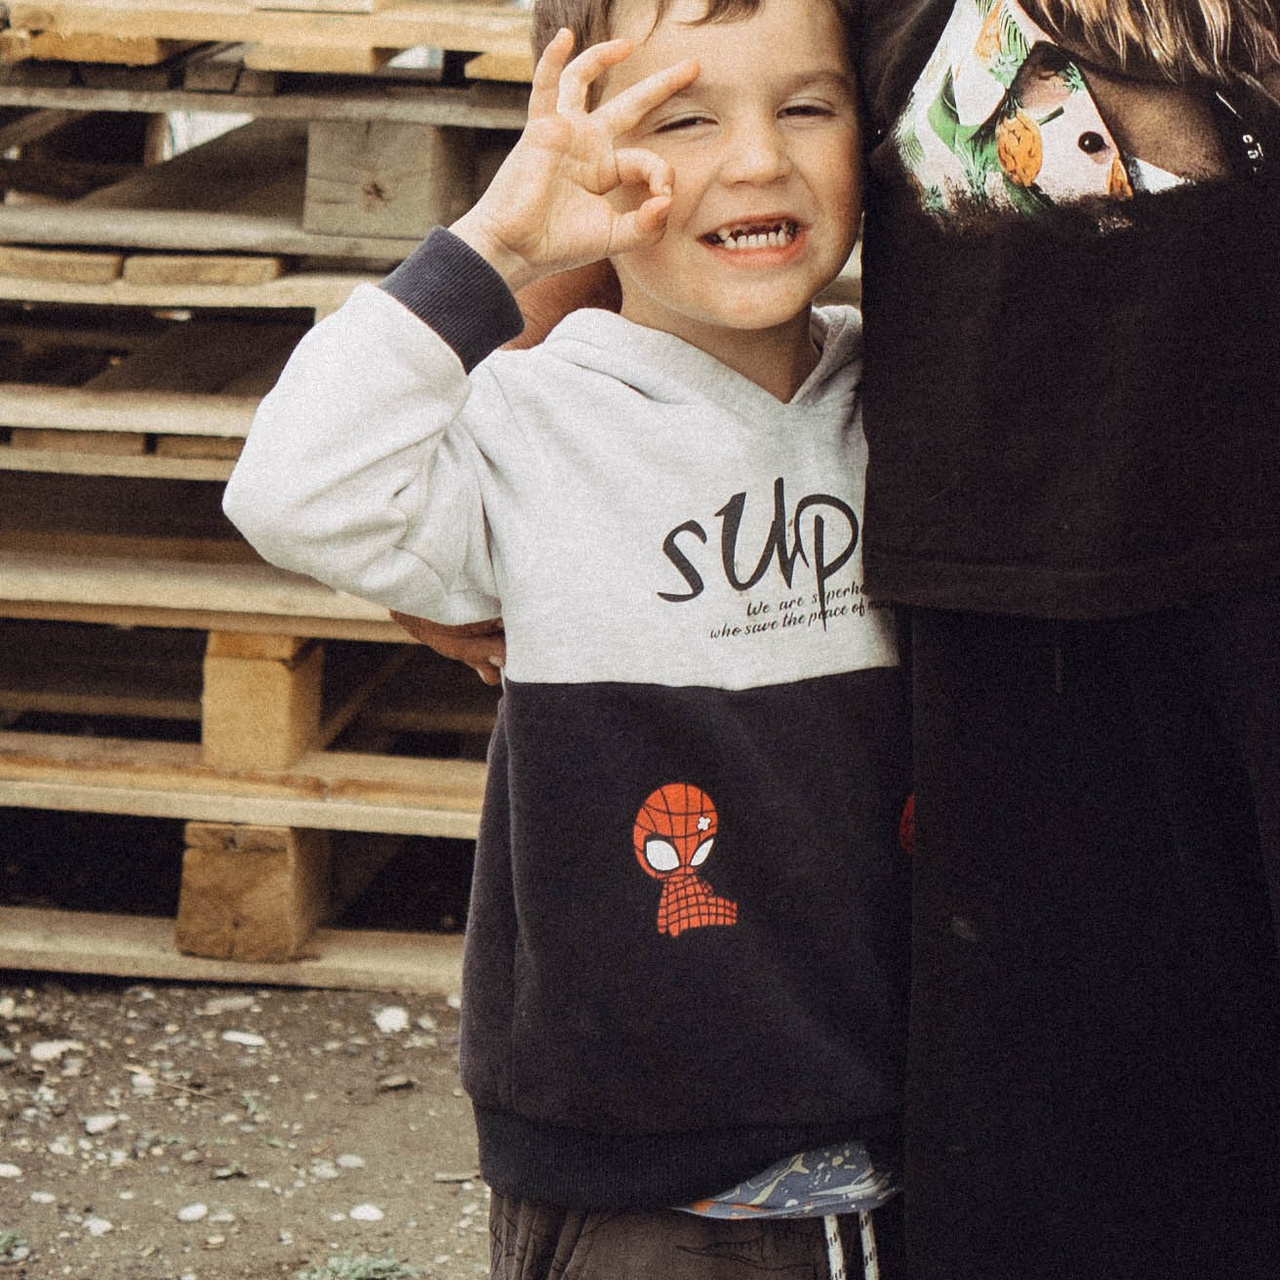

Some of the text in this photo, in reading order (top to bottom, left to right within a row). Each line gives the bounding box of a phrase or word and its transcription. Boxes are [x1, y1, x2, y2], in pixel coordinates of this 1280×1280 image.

[746, 602, 770, 617] We
[779, 597, 804, 610] are
[812, 580, 866, 606] sperh
[710, 623, 742, 638] who
[745, 620, 777, 635] save
[782, 613, 805, 628] the
[851, 598, 866, 617] of
